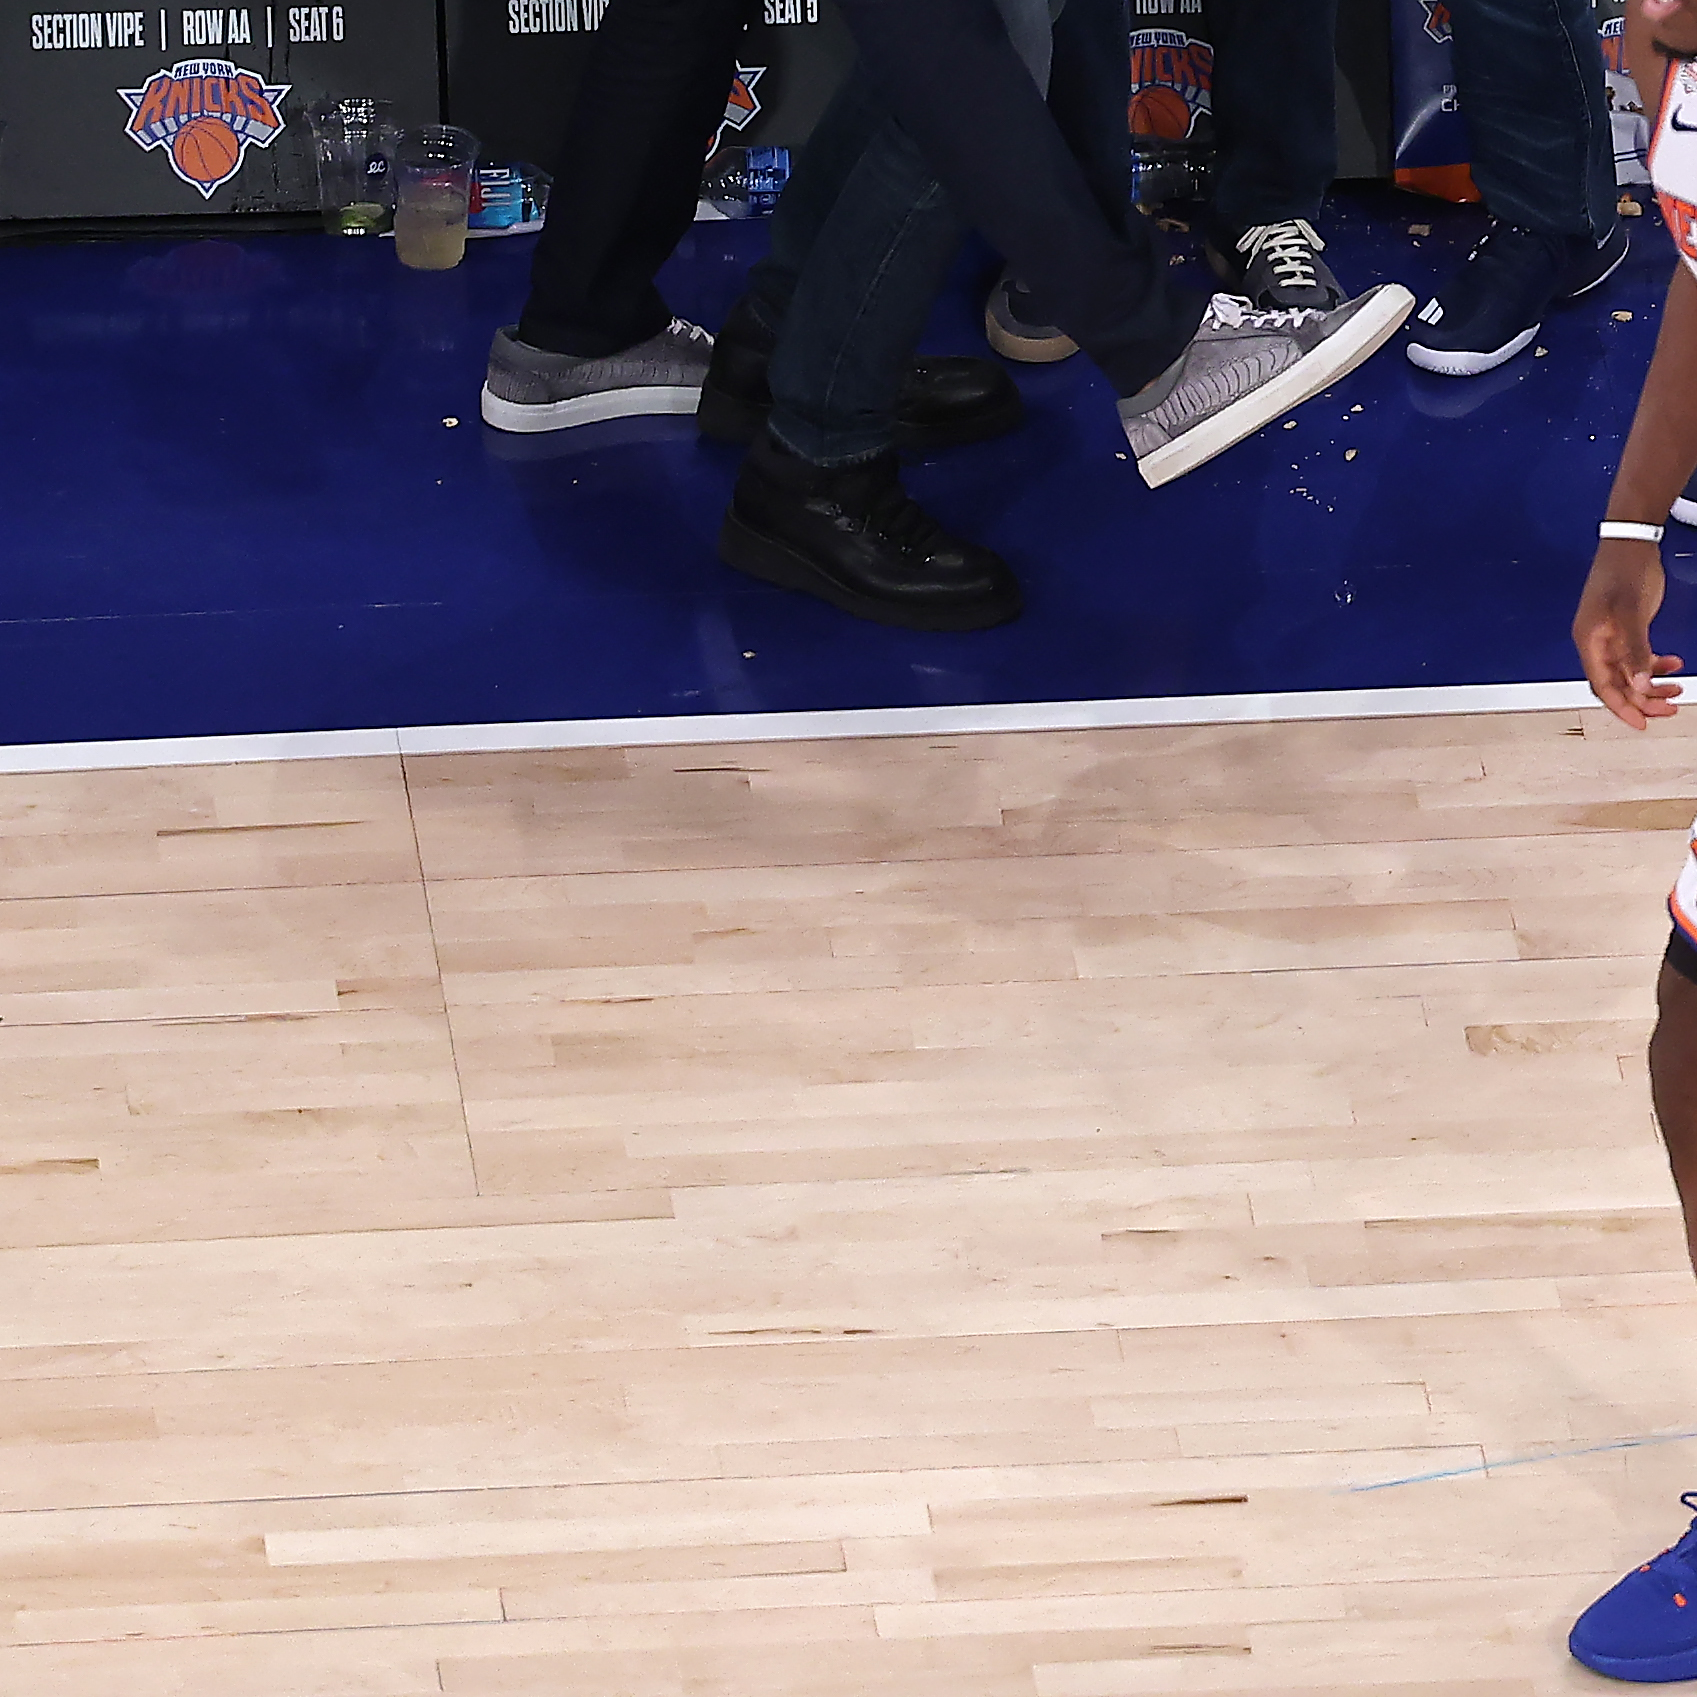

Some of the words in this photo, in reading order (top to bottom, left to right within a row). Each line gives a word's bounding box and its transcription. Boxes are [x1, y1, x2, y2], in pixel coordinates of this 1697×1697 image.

[31, 13, 103, 50] SECTION
[105, 11, 145, 48] VIPE
[182, 9, 224, 45] ROW
[227, 8, 251, 44] AA
[289, 6, 328, 43] SEAT
[332, 6, 345, 42] 6
[1154, 32, 1187, 46] YORK
[174, 63, 200, 79] NEW
[202, 62, 234, 77] YORK
[1131, 44, 1213, 91] NICKS
[132, 74, 279, 132] KNICKS
